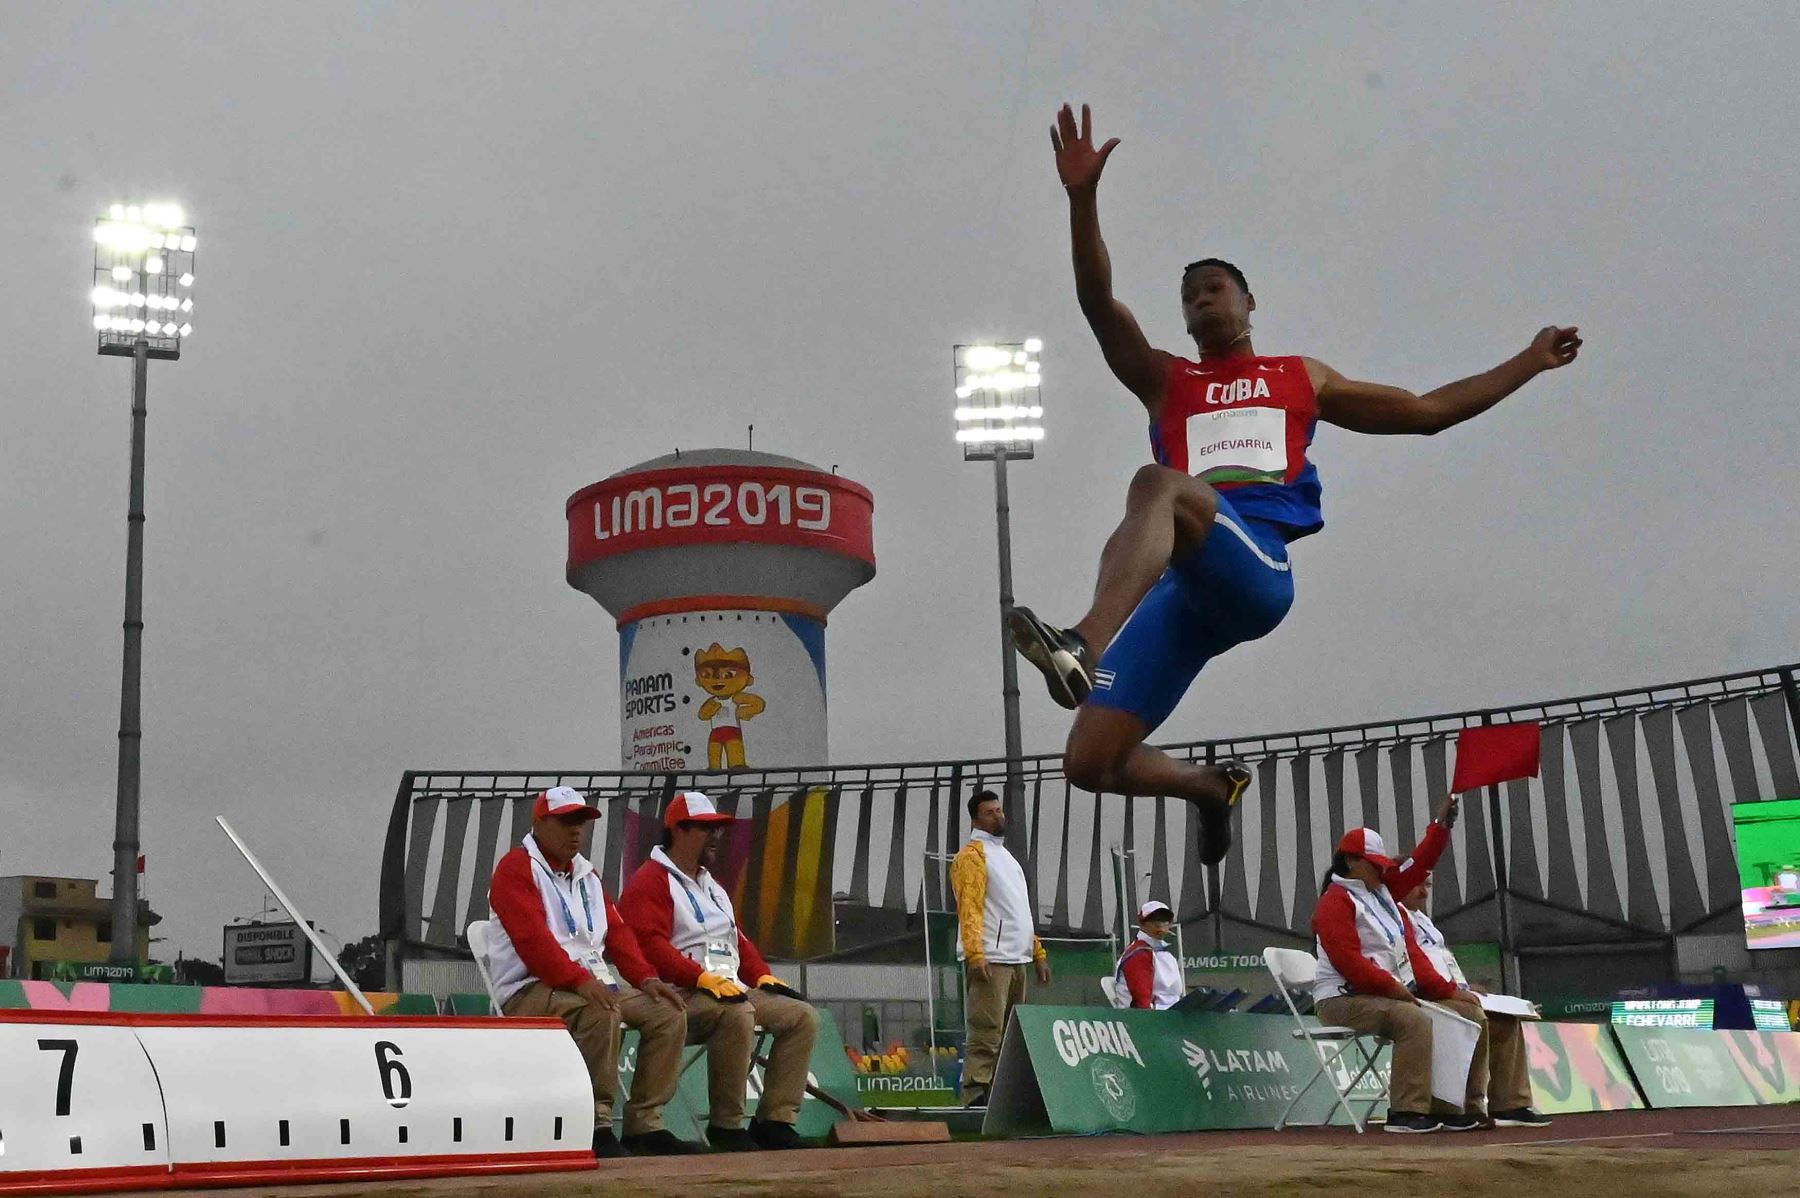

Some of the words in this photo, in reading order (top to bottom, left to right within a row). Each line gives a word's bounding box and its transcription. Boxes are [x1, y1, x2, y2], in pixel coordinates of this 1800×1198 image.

[1205, 377, 1271, 404] CUBA
[1200, 438, 1274, 457] ECHEVARRIA
[625, 672, 673, 701] PANAM
[625, 693, 677, 720] SPORTS
[632, 724, 675, 742] Americas
[633, 740, 685, 759] Paralympic
[237, 929, 295, 943] DISPONIBLE
[1052, 1019, 1146, 1068] GLORIA
[1210, 1049, 1291, 1074] LATAM
[37, 1039, 79, 1117] 7
[373, 1040, 413, 1109] 6
[1227, 1084, 1299, 1102] AIRLINES
